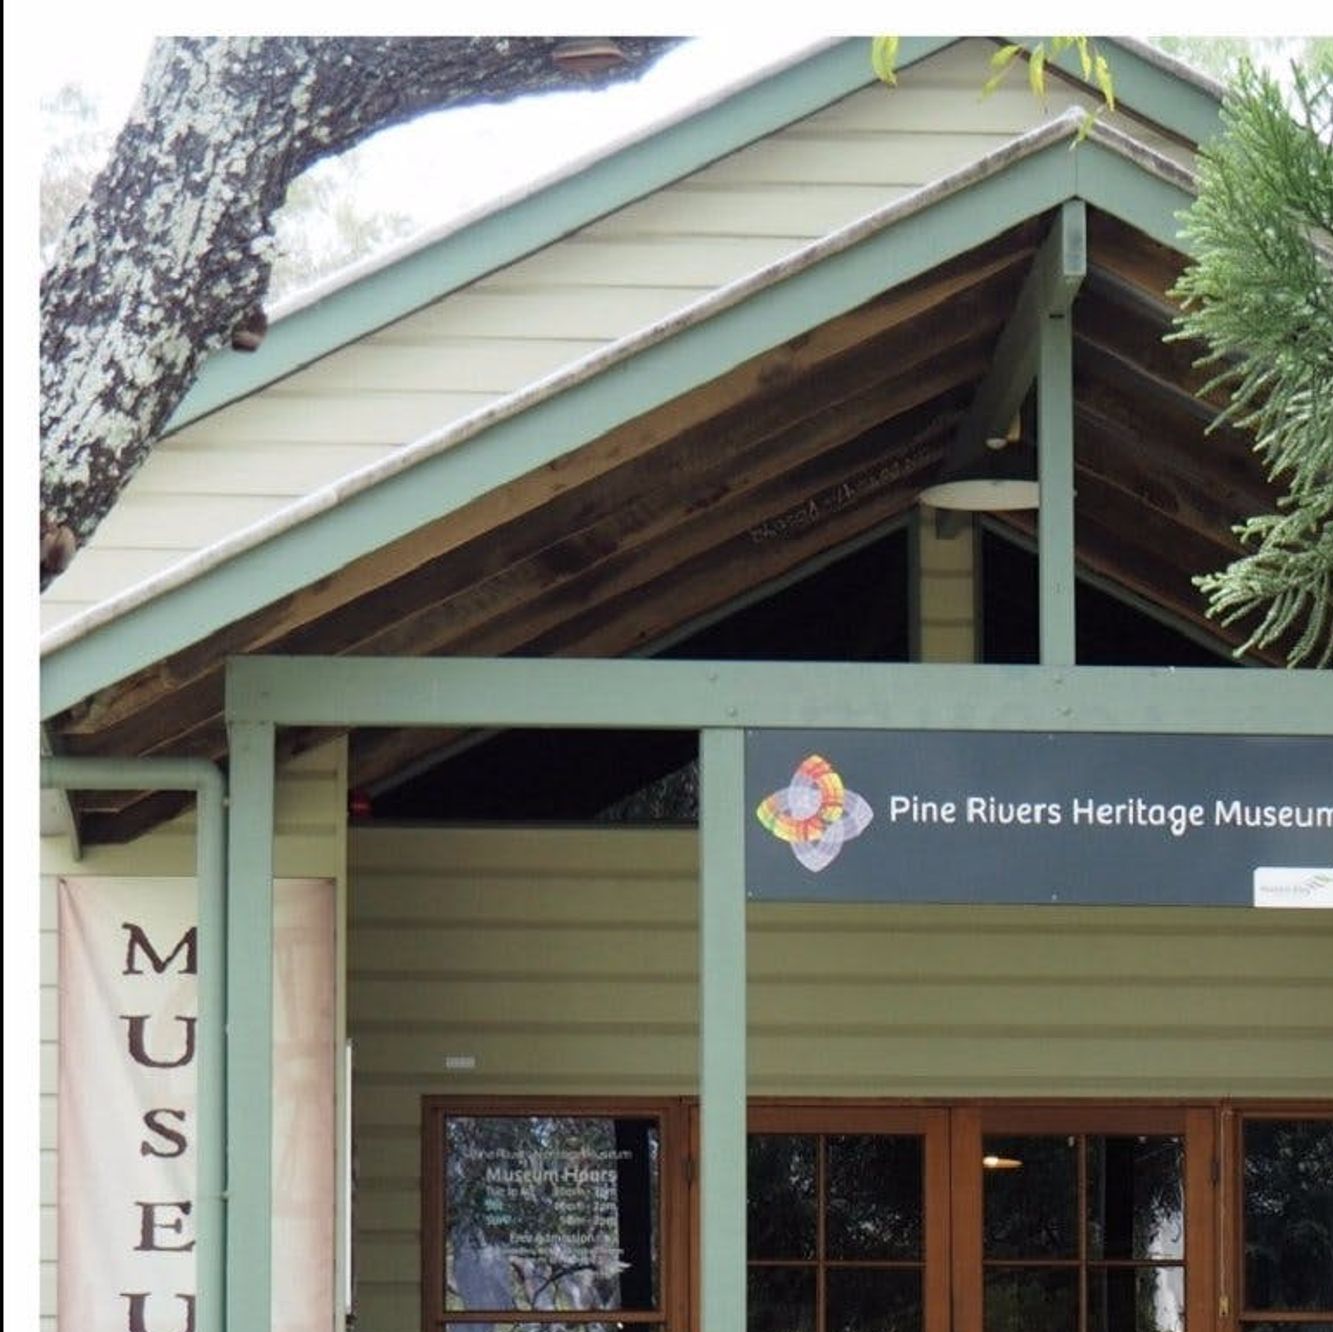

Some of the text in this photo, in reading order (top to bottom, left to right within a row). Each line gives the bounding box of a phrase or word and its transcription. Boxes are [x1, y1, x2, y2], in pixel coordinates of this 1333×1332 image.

[889, 795, 956, 823] Pine
[966, 796, 1062, 825] Rivers
[1072, 798, 1204, 835] Heritage
[485, 1167, 618, 1183] Museum Hours
